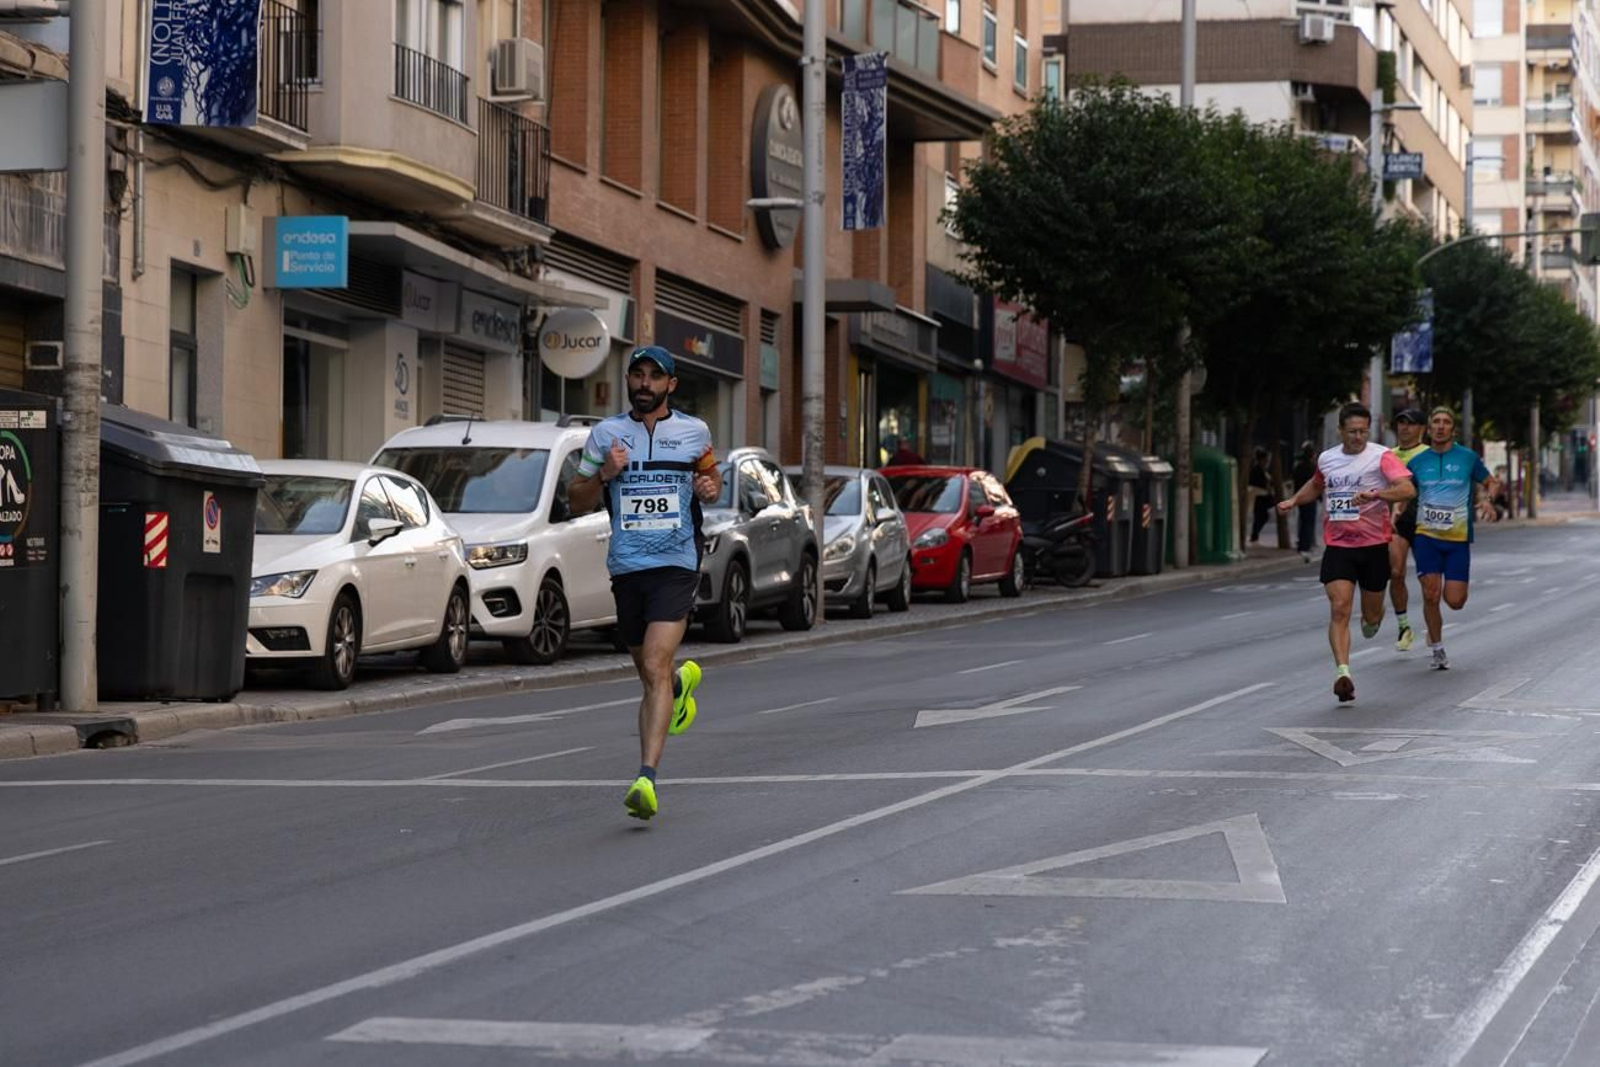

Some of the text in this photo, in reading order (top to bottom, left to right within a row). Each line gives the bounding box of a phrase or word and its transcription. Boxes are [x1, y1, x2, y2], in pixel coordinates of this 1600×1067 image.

[170, 23, 186, 67] JUAN
[283, 231, 336, 245] endesa
[290, 261, 335, 273] Servicio
[561, 333, 602, 351] Jucar
[630, 497, 669, 514] 798
[1424, 510, 1452, 522] 1002
